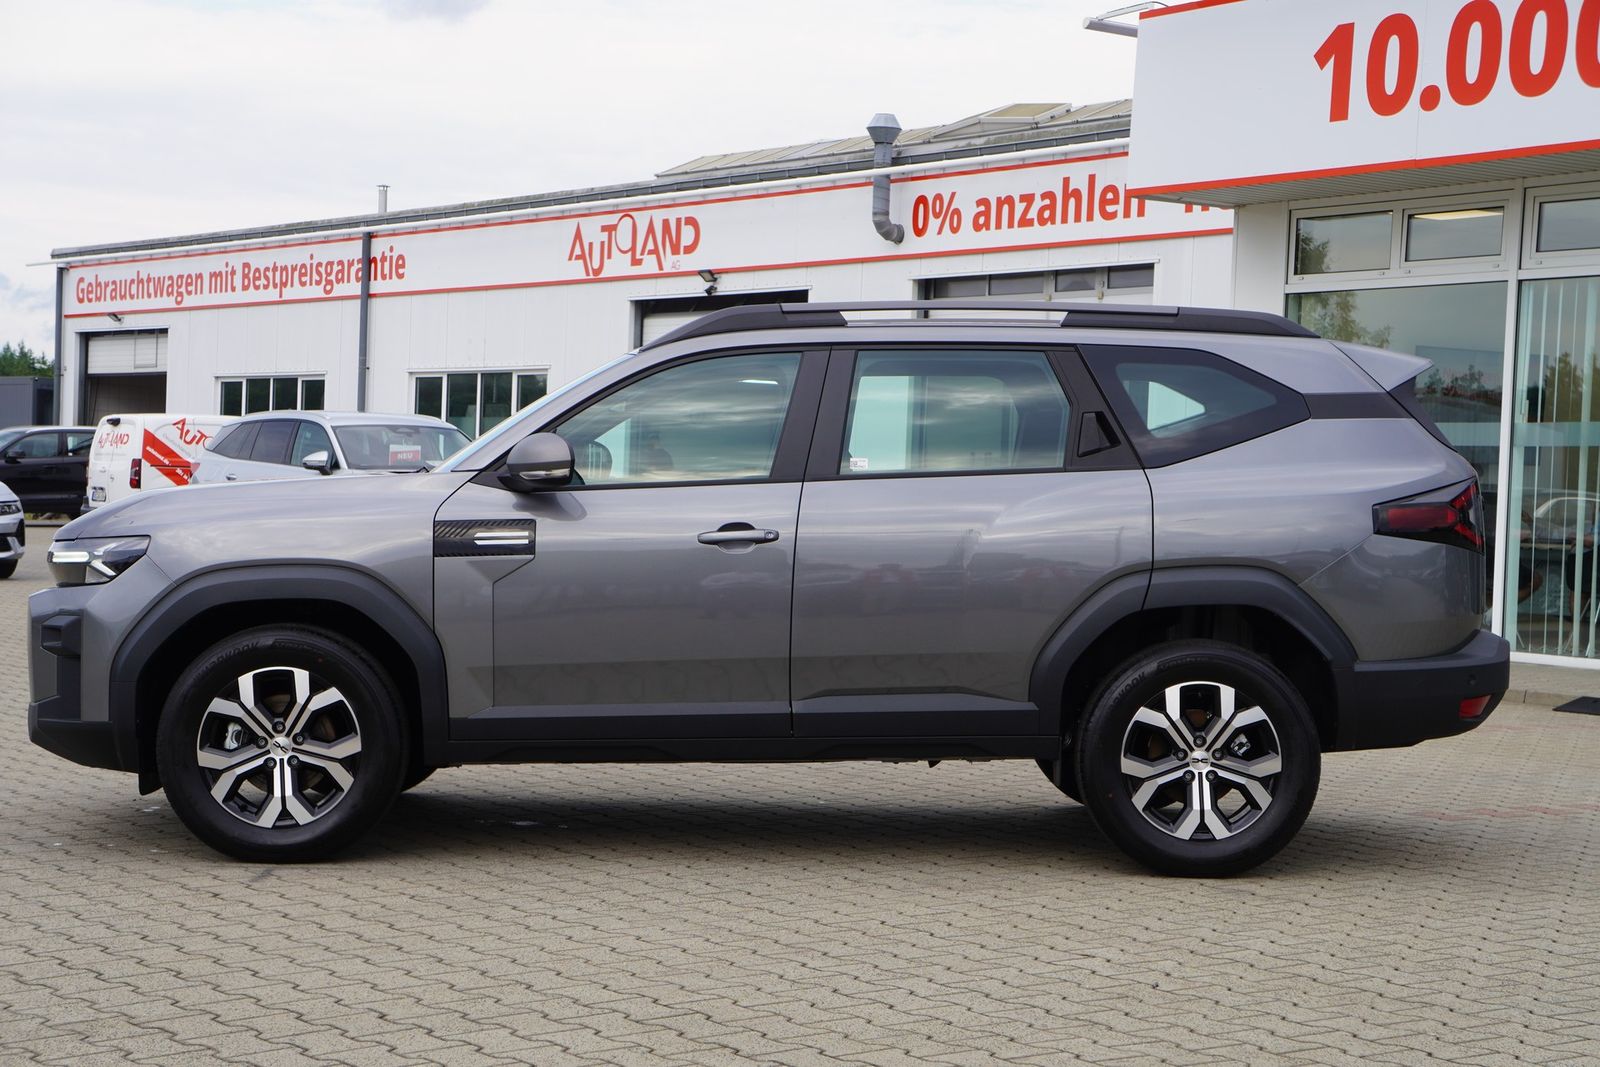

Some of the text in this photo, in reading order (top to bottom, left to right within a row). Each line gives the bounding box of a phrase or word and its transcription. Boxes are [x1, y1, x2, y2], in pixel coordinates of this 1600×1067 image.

[912, 174, 1145, 238] 0% anzahlen
[76, 245, 406, 305] Gebrauchtwagen mit Bestpreisgarantie
[568, 213, 701, 277] AUTOLAND
[671, 260, 681, 270] AG
[98, 432, 130, 449] AUTLAND
